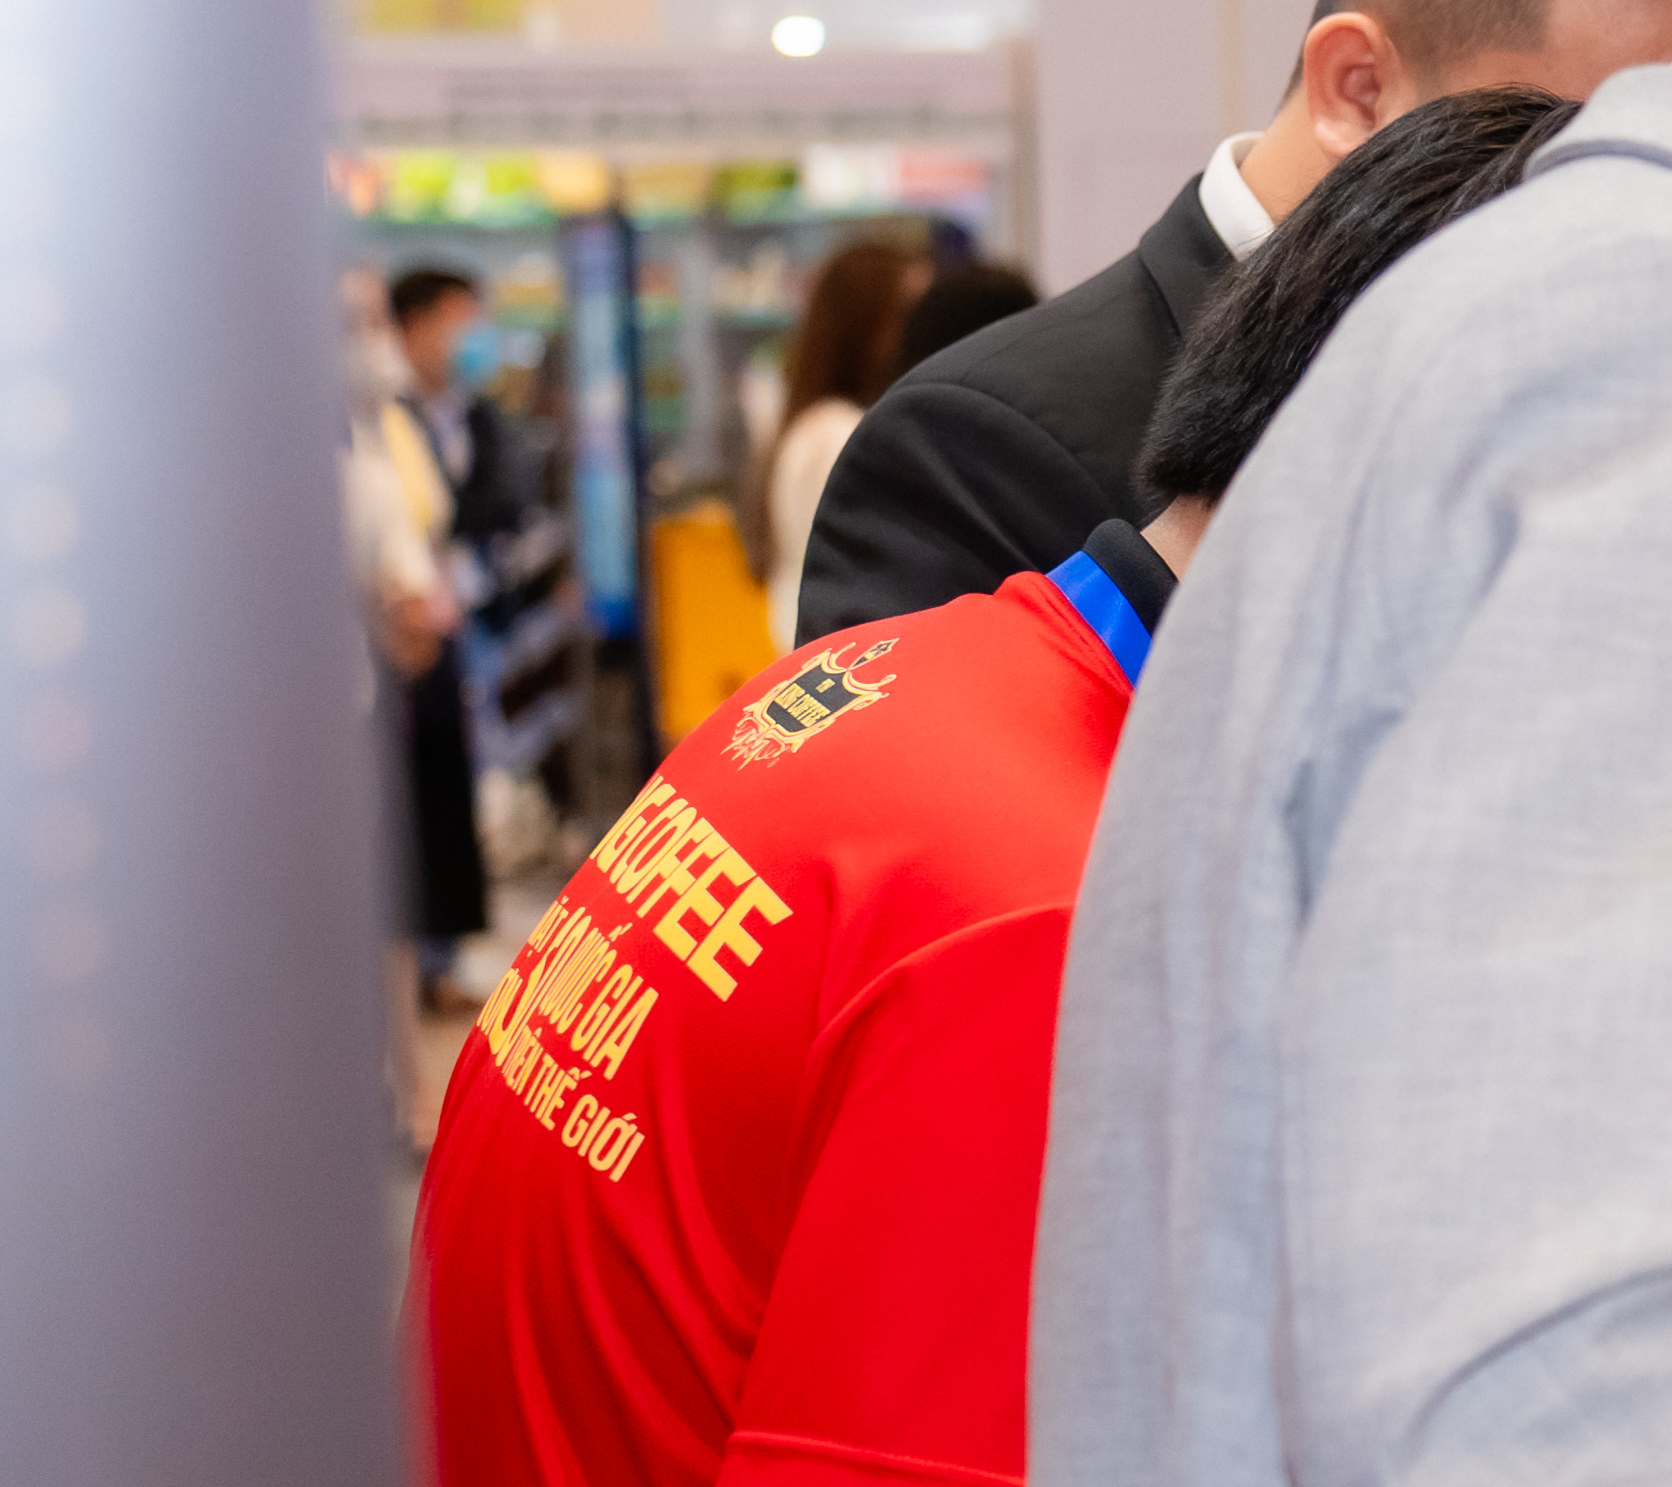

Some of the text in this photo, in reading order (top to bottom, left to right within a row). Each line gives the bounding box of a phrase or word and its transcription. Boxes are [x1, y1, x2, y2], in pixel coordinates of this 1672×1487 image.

[571, 963, 659, 1081] GIA
[523, 1053, 592, 1132] THẾ
[561, 1092, 646, 1183] GIỚI
